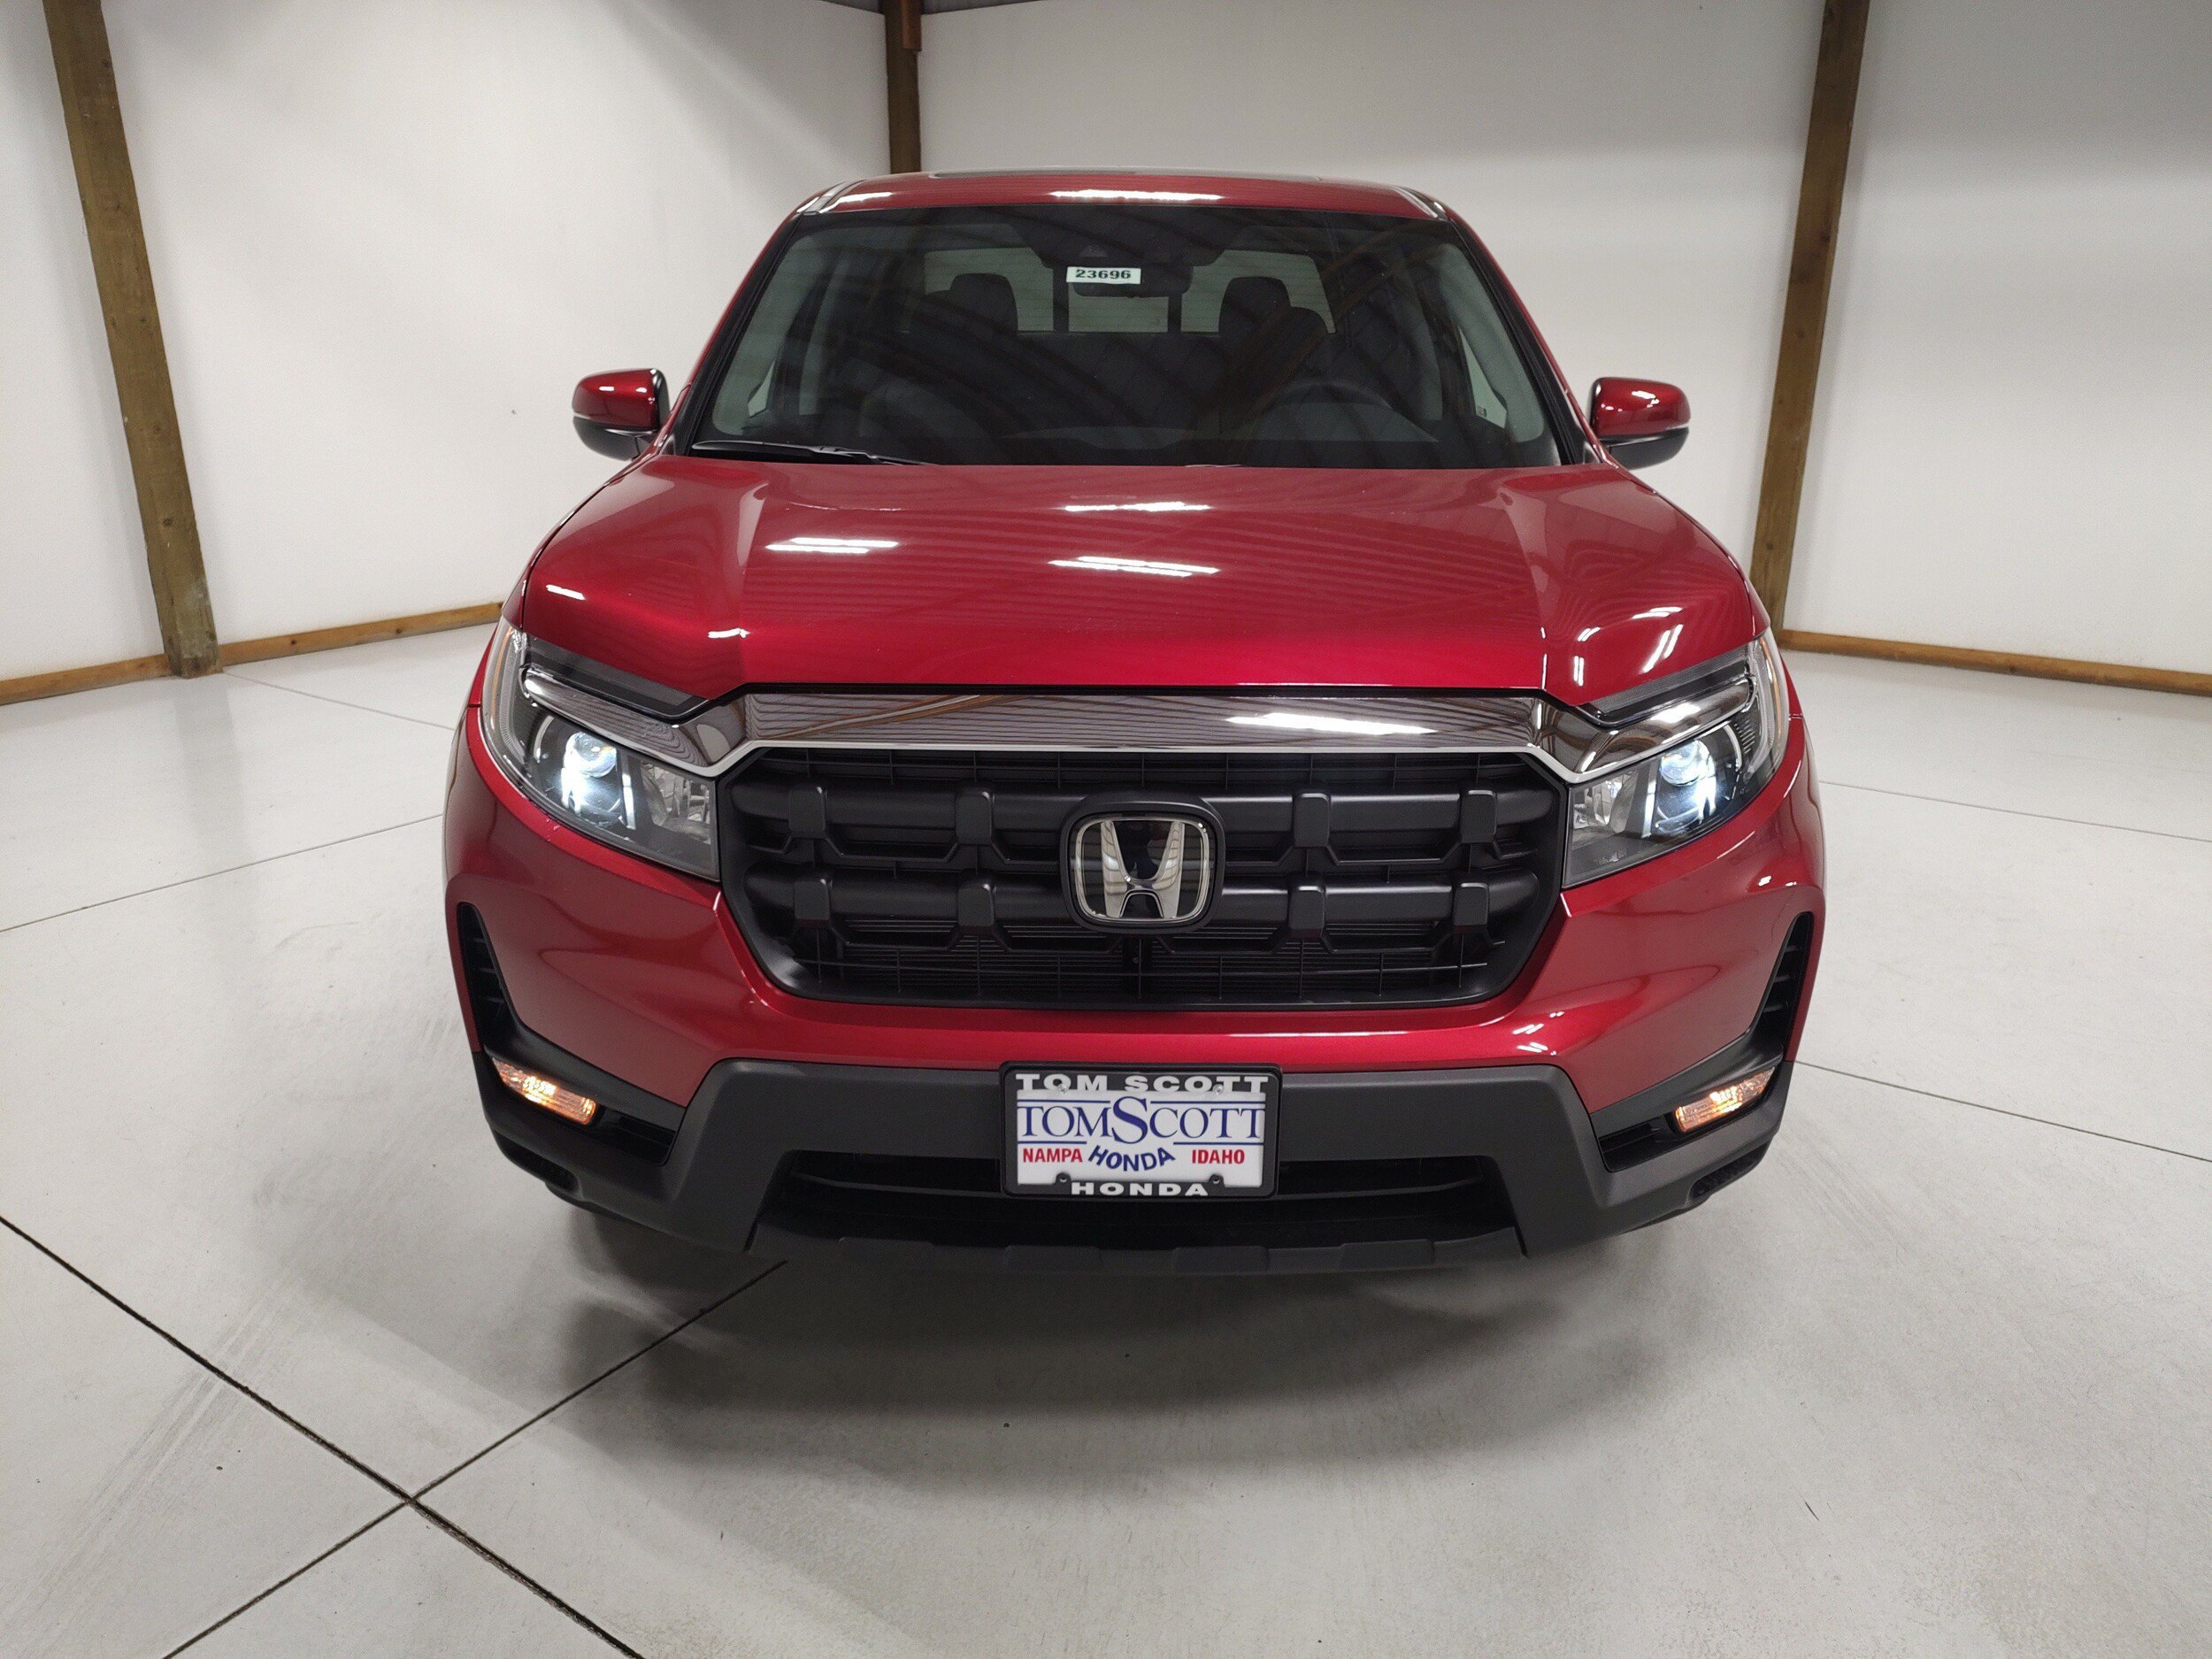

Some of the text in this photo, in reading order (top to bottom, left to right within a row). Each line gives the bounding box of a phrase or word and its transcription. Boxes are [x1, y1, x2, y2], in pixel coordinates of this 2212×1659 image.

[1075, 269, 1132, 279] 23696
[1016, 1073, 1269, 1093] TOM SCOTT
[1023, 1148, 1083, 1163] NAMPA
[1088, 1145, 1176, 1171] HONDA
[1191, 1148, 1245, 1164] IDAHO
[1071, 1182, 1209, 1196] HONDA
